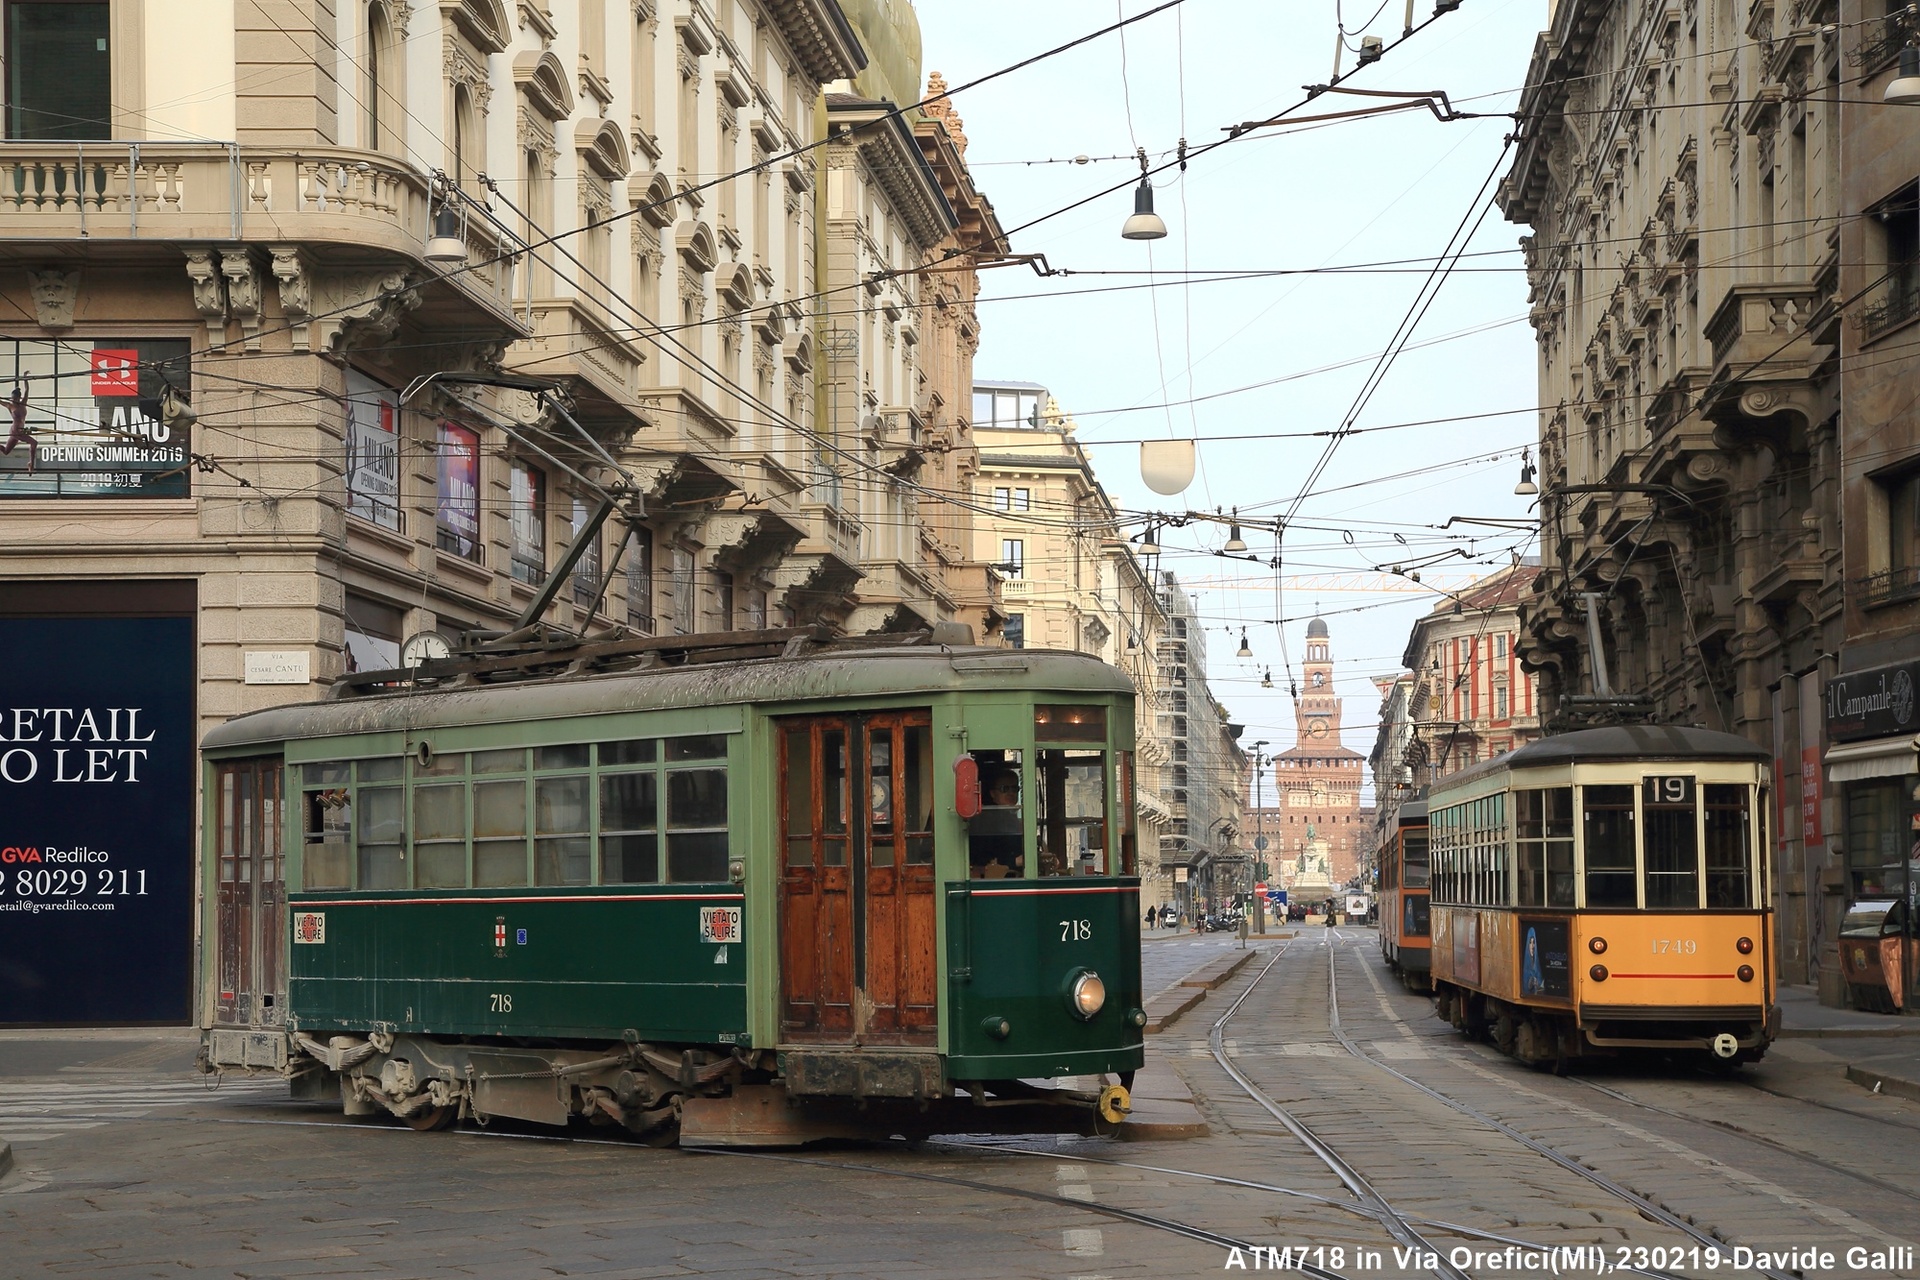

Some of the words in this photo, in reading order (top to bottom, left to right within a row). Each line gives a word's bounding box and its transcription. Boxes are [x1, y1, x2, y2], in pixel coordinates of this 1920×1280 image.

[41, 447, 97, 462] OPENING
[97, 447, 149, 462] SUMMER
[151, 446, 183, 462] 2019
[364, 436, 394, 481] MILANO
[450, 476, 475, 517] MILANO
[1828, 684, 1835, 719] il
[1837, 674, 1891, 719] Campanile
[52, 748, 148, 783] LET
[1653, 777, 1685, 802] 19
[1, 847, 42, 863] GVA
[45, 847, 109, 863] Redilco
[15, 869, 87, 896] 8029
[97, 869, 149, 896] 211
[297, 916, 323, 928] VIETATO
[703, 911, 739, 924] VIETATO
[298, 929, 322, 940] SALIRE
[705, 926, 736, 938] SALIRE
[1059, 919, 1091, 942] 718
[1652, 939, 1697, 954] 1749
[490, 993, 512, 1013] 718
